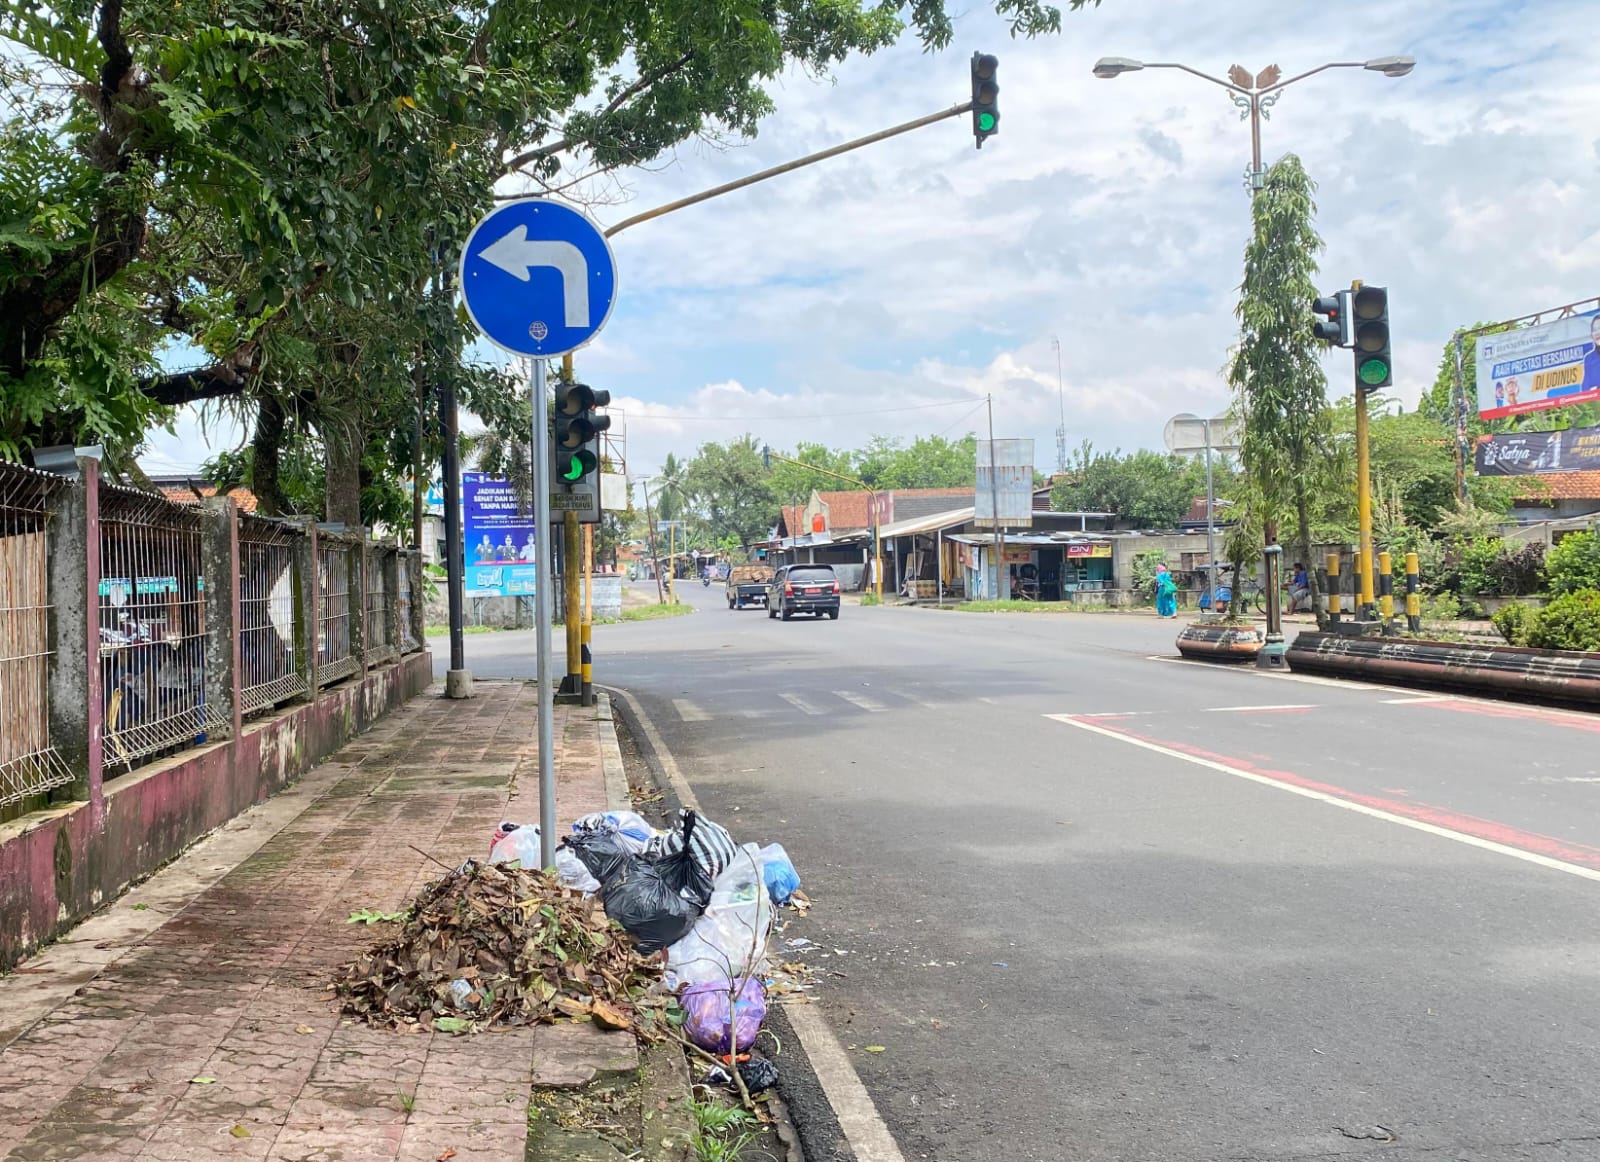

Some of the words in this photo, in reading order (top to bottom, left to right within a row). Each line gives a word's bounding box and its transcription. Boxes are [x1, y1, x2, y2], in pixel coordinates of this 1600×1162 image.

[1546, 368, 1578, 388] UDINUS
[1498, 445, 1531, 465] Satya
[477, 487, 505, 495] JADIKAN
[479, 502, 500, 510] TANPA
